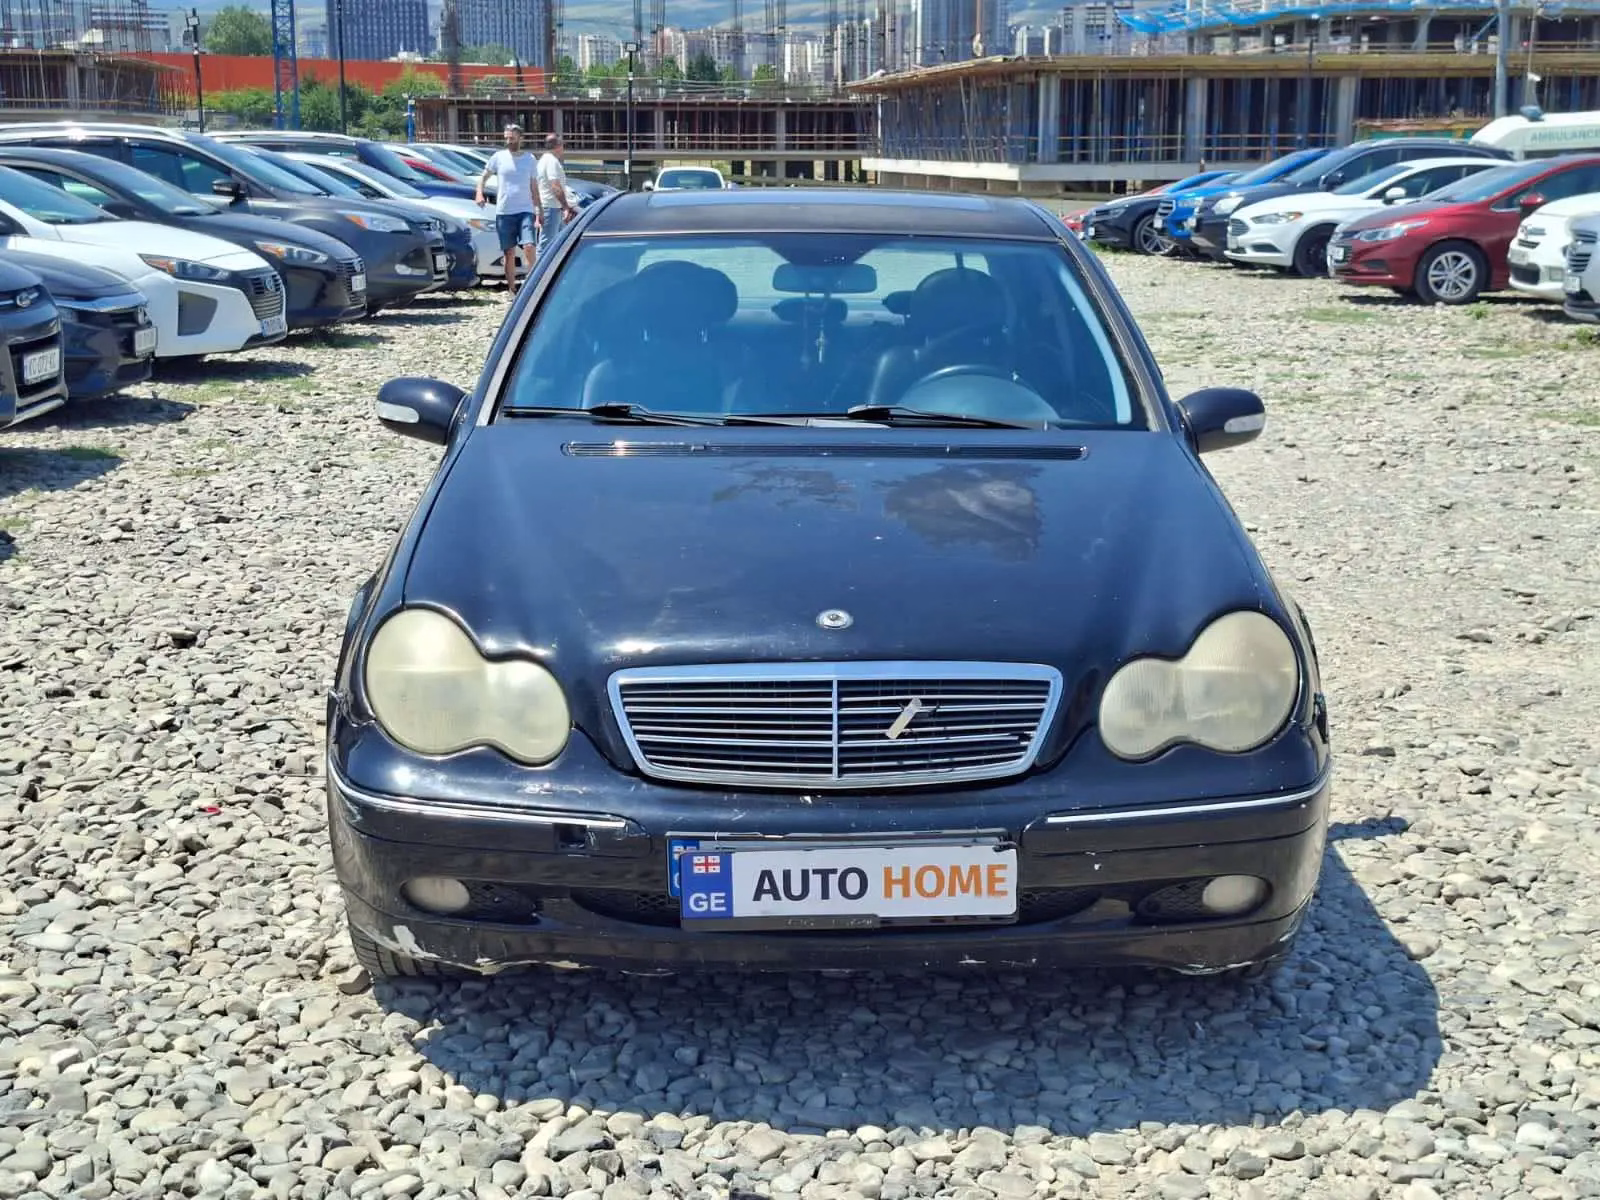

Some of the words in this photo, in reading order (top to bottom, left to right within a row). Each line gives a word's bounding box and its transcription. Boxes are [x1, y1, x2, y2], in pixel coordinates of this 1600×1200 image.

[752, 867, 869, 902] AUTO
[882, 864, 1008, 899] HOME
[689, 892, 727, 912] GE
